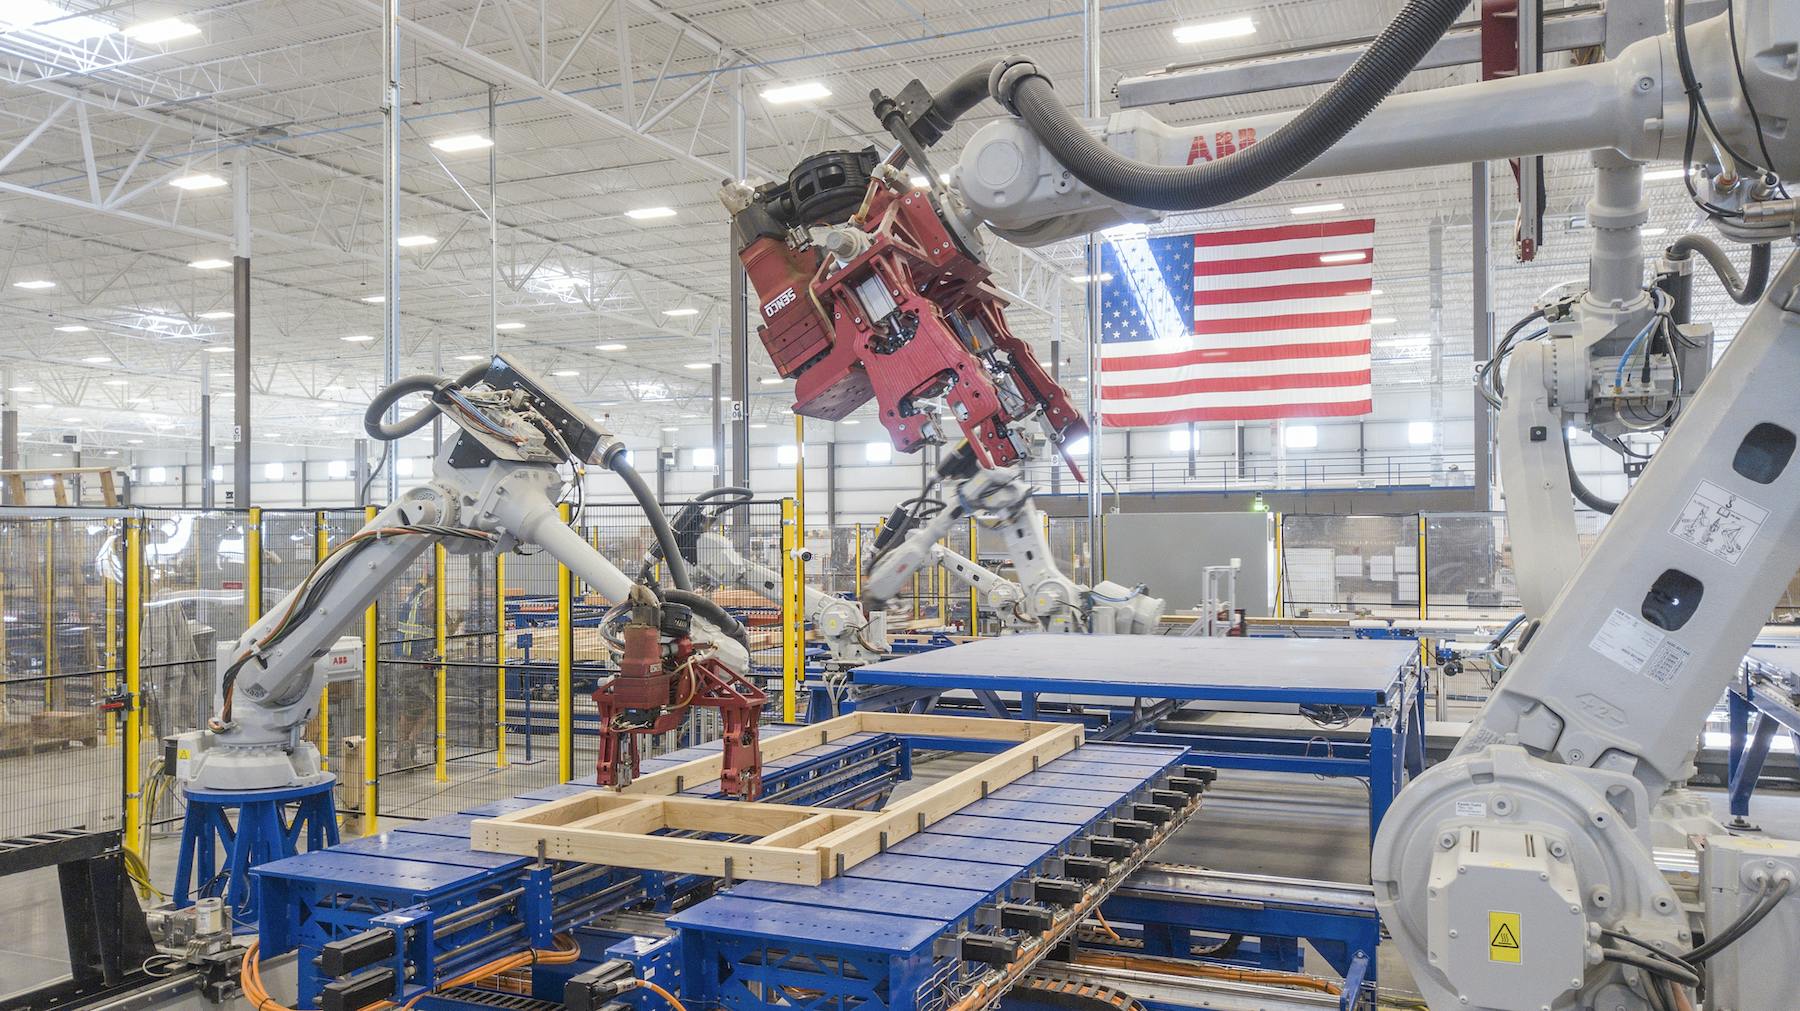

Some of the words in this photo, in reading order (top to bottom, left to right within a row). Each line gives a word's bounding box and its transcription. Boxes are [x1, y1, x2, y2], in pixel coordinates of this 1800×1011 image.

[1186, 127, 1257, 166] ABB
[764, 288, 797, 318] SENCO
[1474, 364, 1484, 374] C
[733, 403, 741, 411] C
[332, 656, 348, 665] ABB
